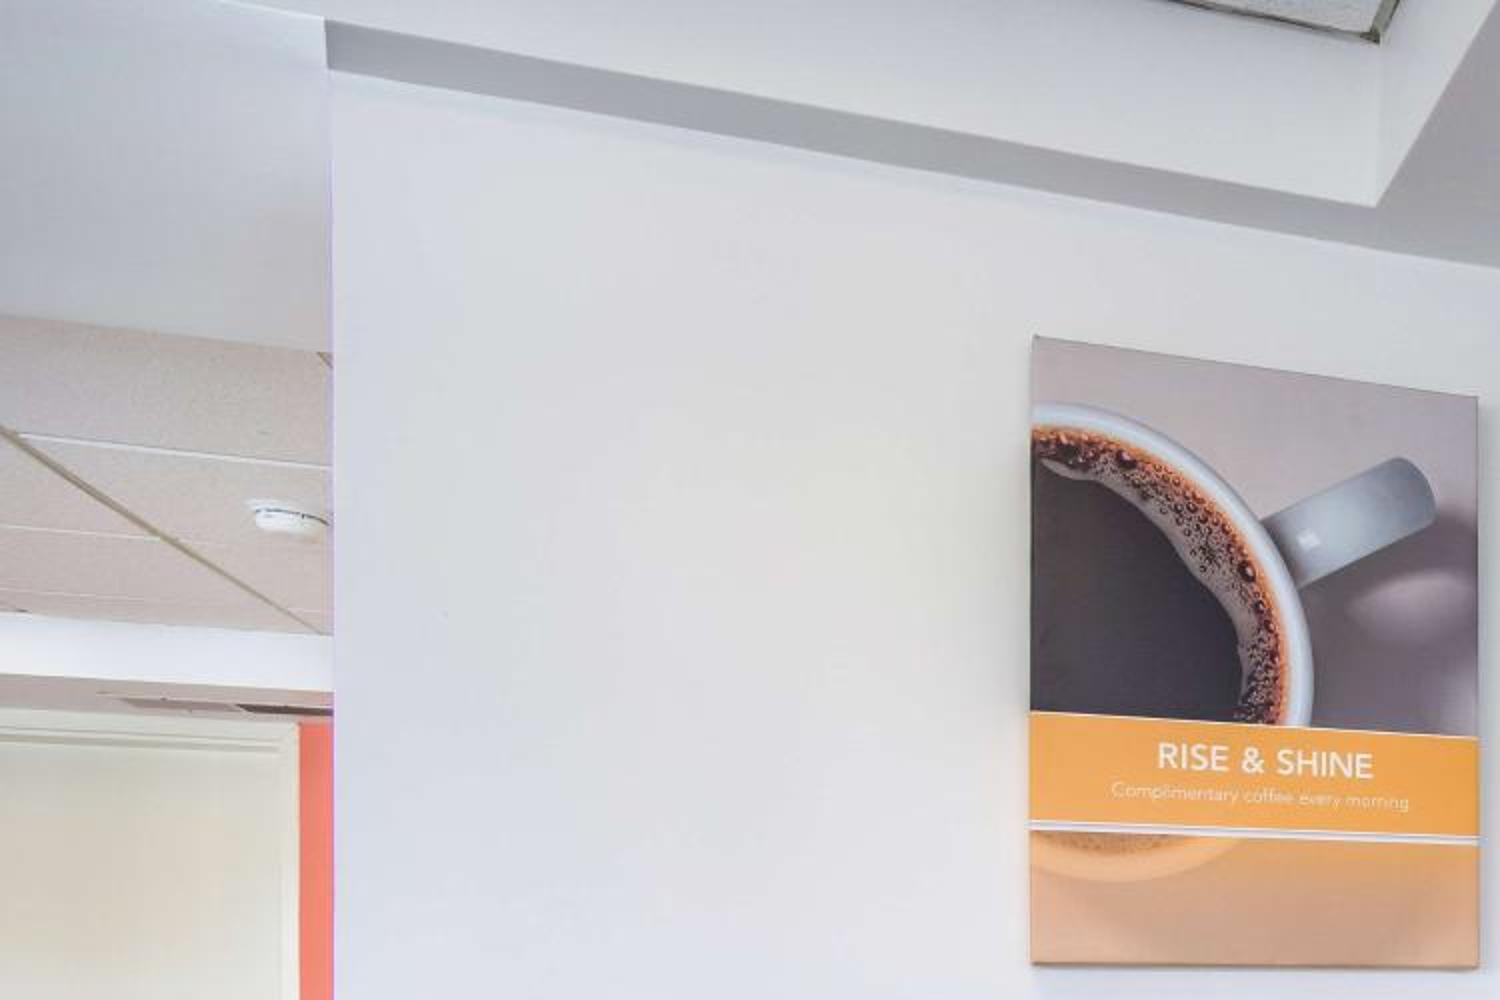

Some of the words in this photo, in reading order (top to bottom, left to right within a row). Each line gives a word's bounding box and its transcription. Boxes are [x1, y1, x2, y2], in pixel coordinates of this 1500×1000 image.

[1158, 742, 1230, 771] RISE
[1241, 746, 1265, 773] &
[1277, 749, 1374, 779] SHINE
[1111, 781, 1239, 804] Complimentary
[1246, 786, 1294, 805] coffee
[1299, 794, 1342, 810] every
[1346, 796, 1409, 813] morning
